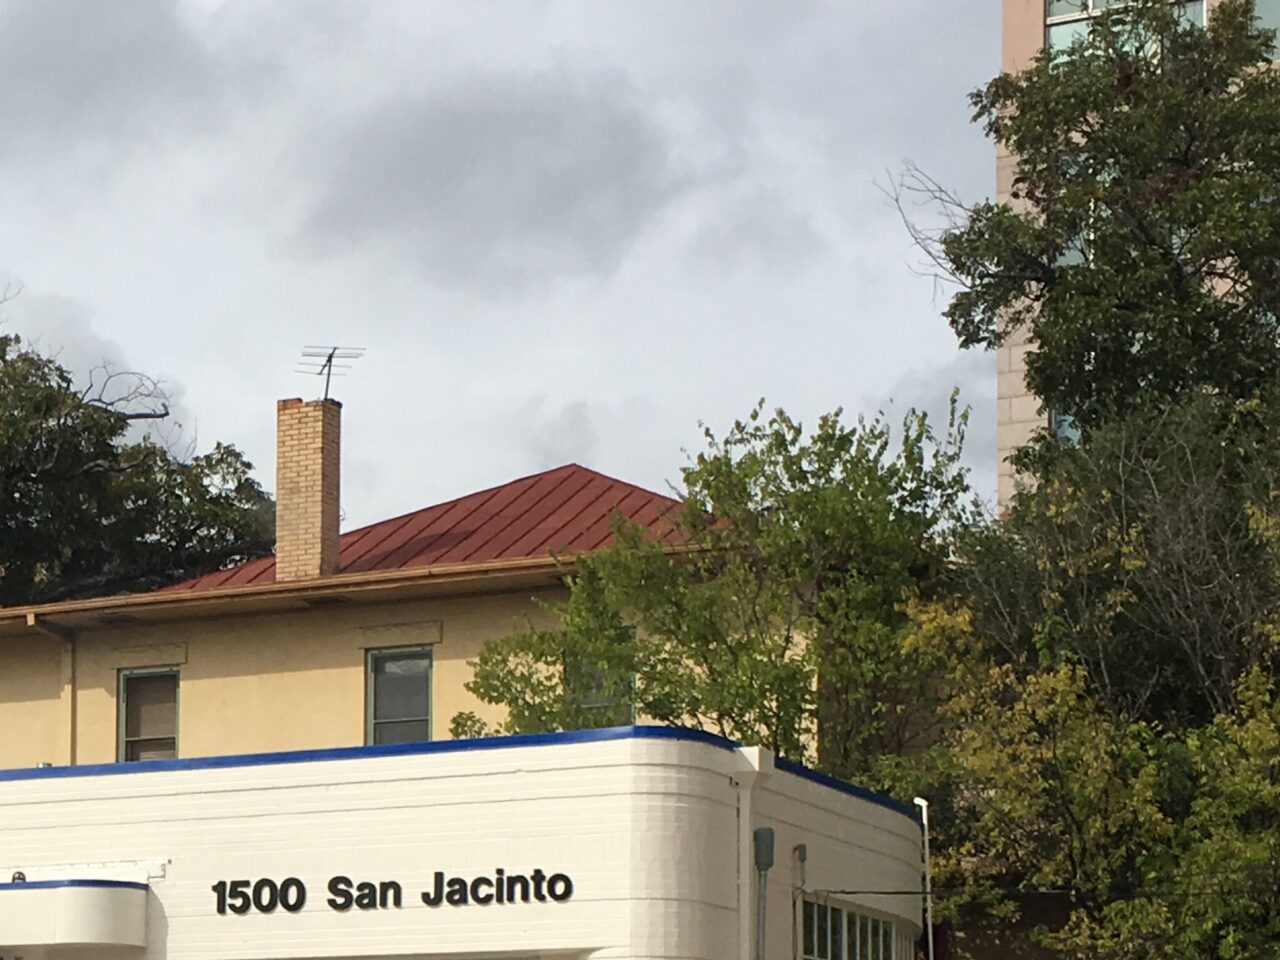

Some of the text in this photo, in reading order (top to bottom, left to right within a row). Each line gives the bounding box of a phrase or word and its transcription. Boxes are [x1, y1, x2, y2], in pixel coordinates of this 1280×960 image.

[212, 868, 573, 915] 1500 San Jacinto
